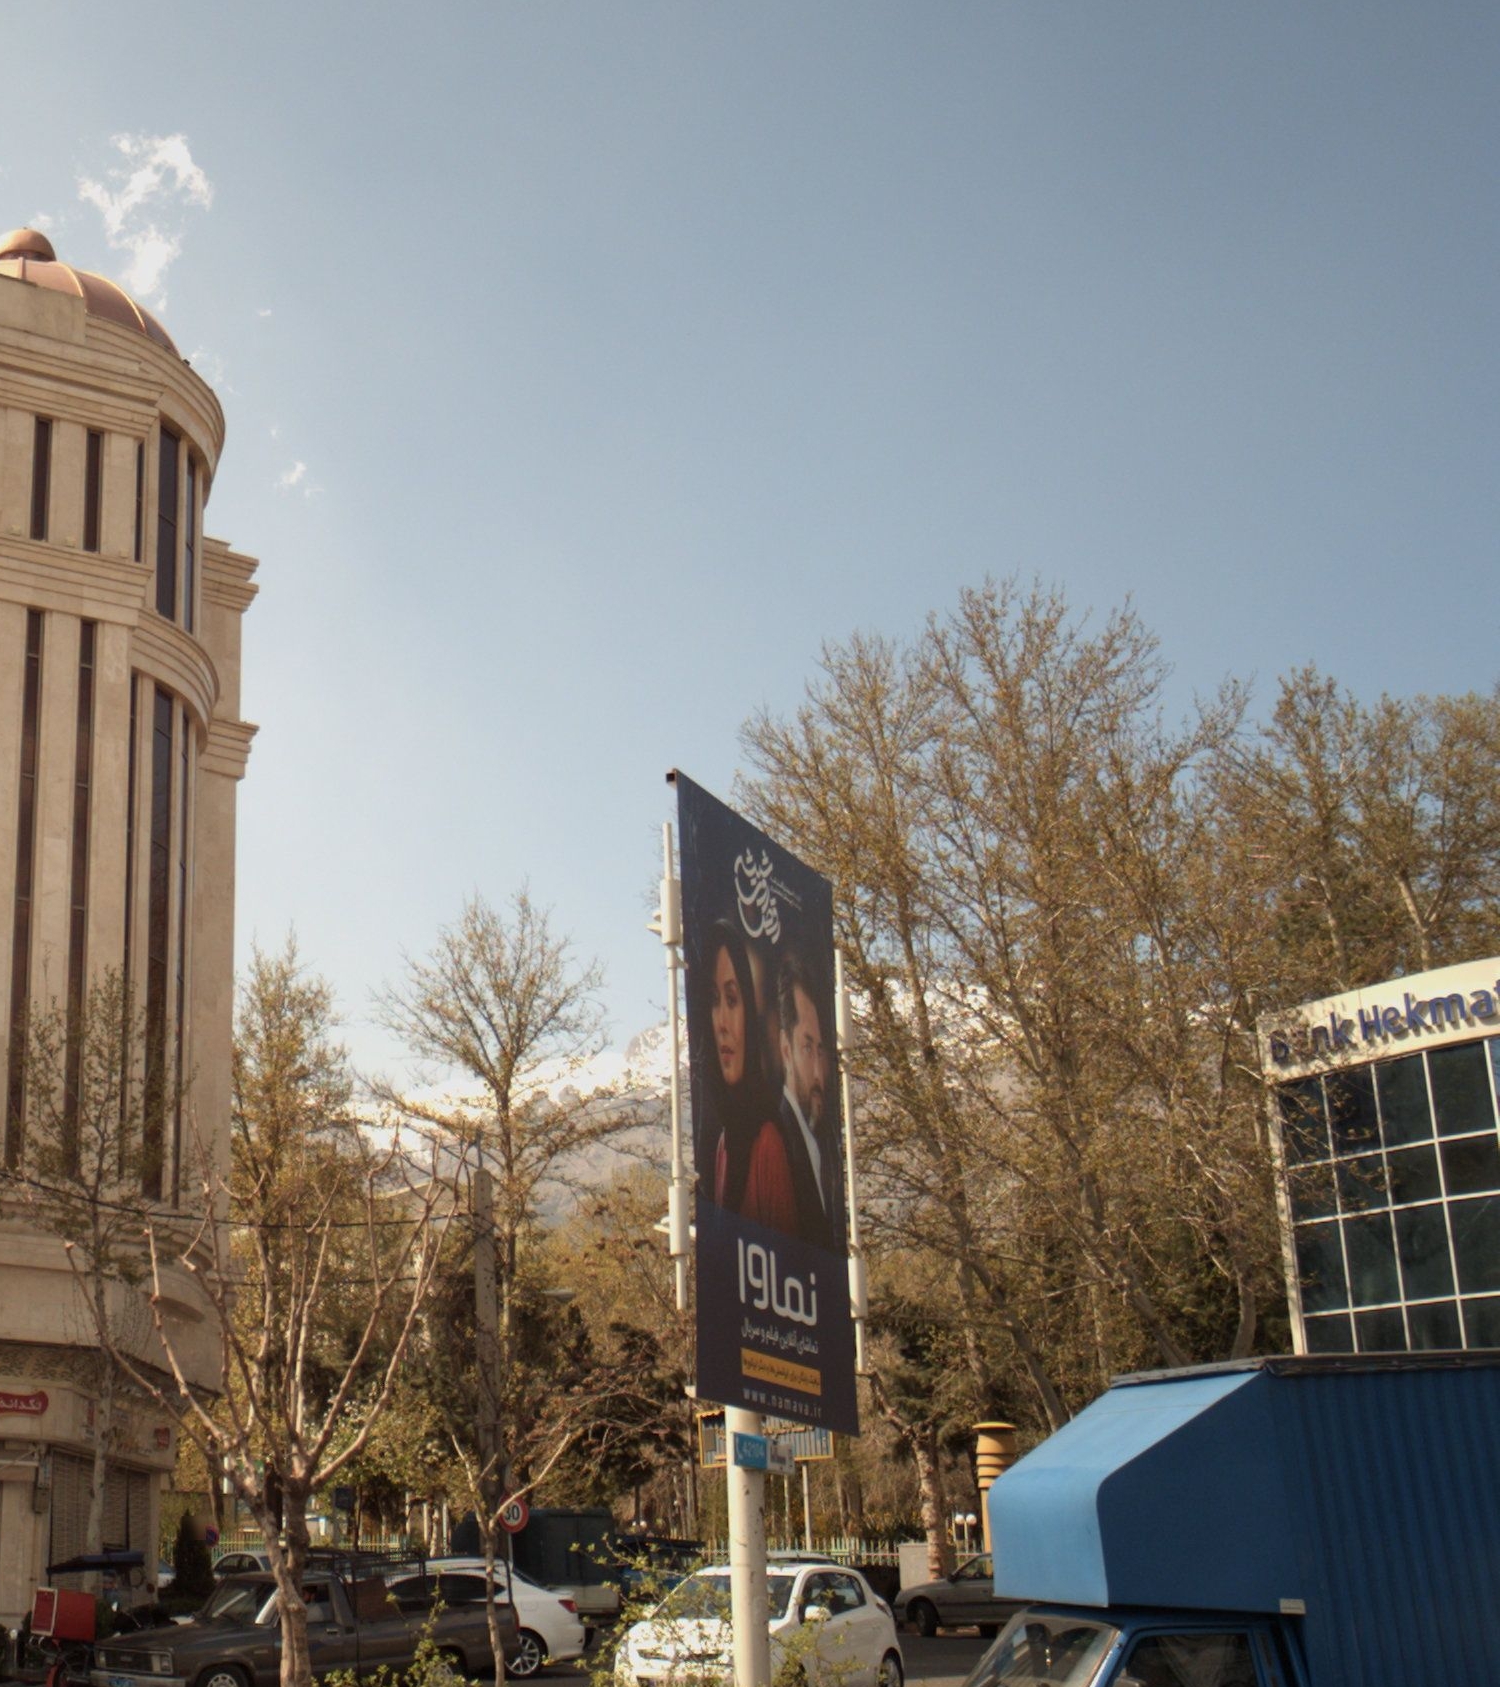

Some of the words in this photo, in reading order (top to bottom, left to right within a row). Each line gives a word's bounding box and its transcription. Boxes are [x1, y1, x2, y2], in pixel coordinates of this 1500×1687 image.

[1269, 1011, 1354, 1063] Bnk
[738, 1237, 818, 1326] نماوا
[742, 1387, 823, 1420] www.namava.ir
